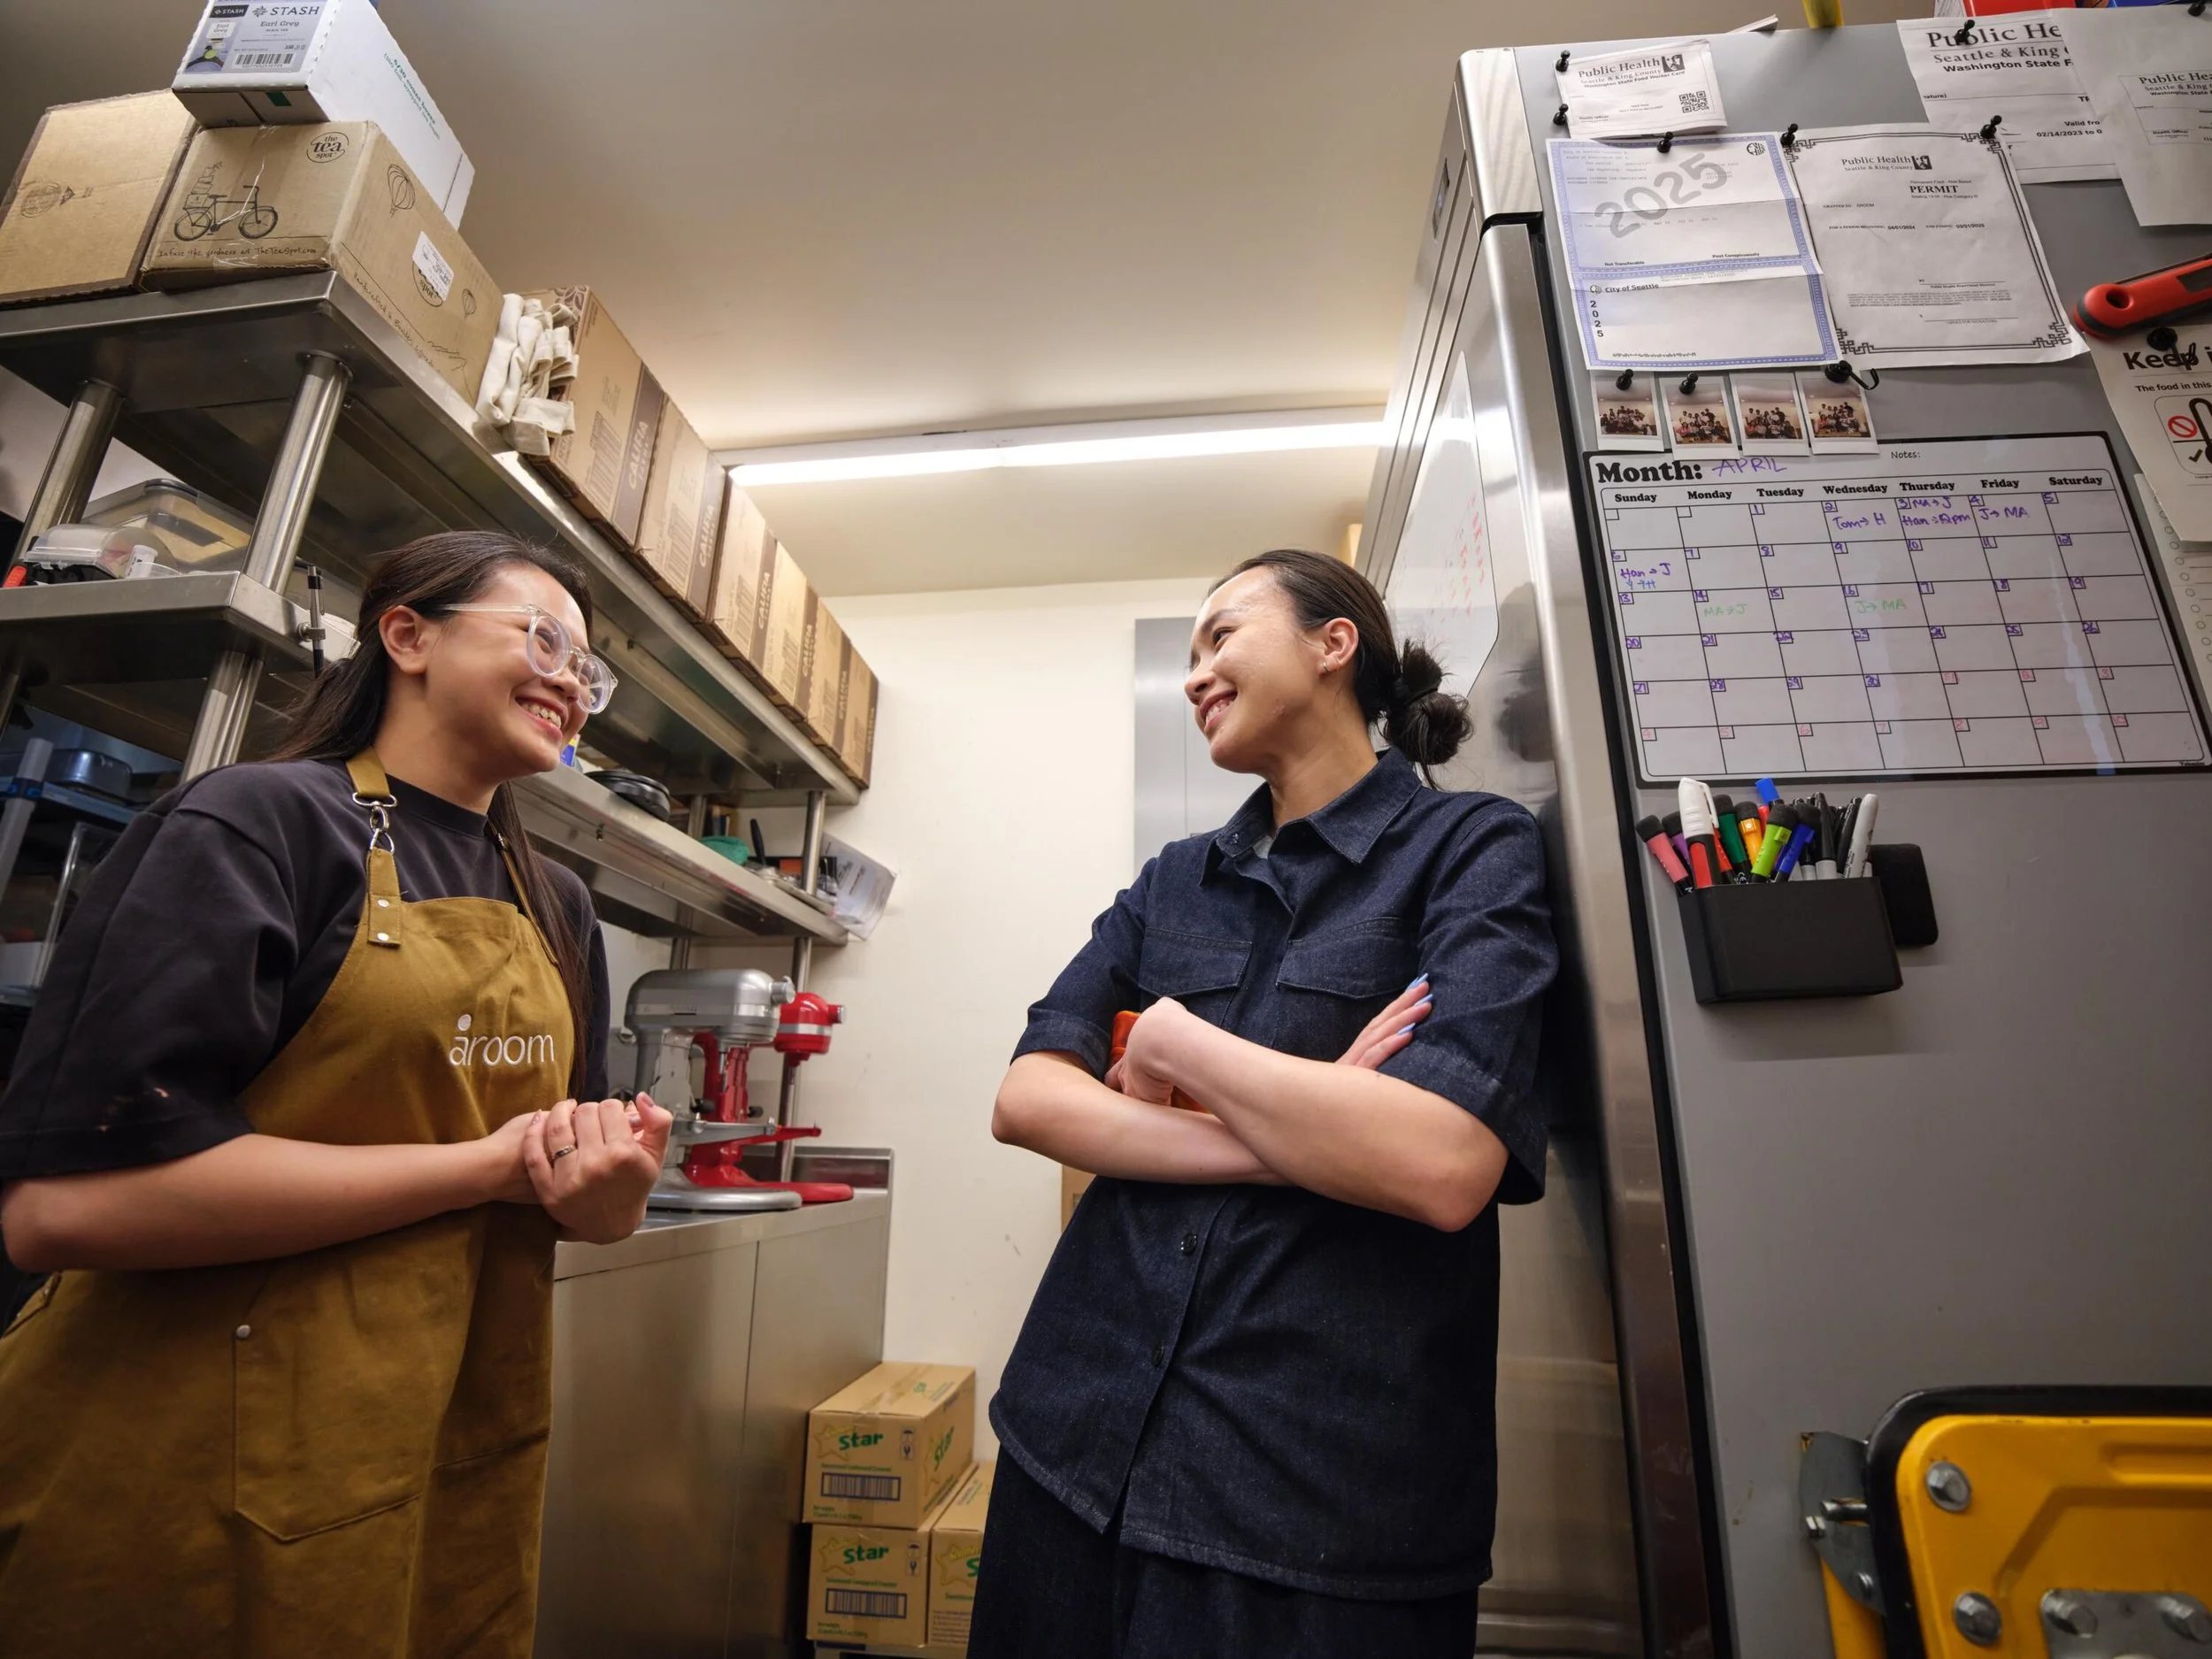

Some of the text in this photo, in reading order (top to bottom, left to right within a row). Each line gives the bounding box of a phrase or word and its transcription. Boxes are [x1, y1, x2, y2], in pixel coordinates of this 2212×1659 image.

[270, 6, 319, 16] STASH
[1933, 46, 2059, 64] Seattle & King
[1578, 58, 1661, 78] Public Health
[1943, 59, 2061, 73] Washington State
[2139, 73, 2186, 84] Public
[313, 142, 342, 152] tea
[1841, 156, 1911, 166] Public Health
[1909, 185, 1959, 194] PERMIT
[1594, 152, 1728, 239] 2025
[157, 249, 185, 258] Infuse
[188, 248, 202, 257] the
[205, 249, 236, 258] goodness
[419, 279, 436, 298] spot
[2123, 351, 2199, 371] Keep
[628, 420, 649, 490] CALIFIA
[1891, 450, 1921, 459] Notes:
[1595, 460, 1703, 483] Month:
[1712, 457, 1787, 478] APRIL
[1614, 476, 2103, 503] Sunday Monday Tuesday Wednesday Thursday Friday Saturday
[1898, 497, 1909, 508] 3
[1969, 495, 1981, 505] 4
[2042, 492, 2055, 503] 5
[1753, 504, 1759, 514] 1
[1824, 502, 1835, 511] 2
[1978, 506, 2029, 520] J MA
[1832, 512, 1886, 531] Tom H
[1902, 514, 1929, 526] Han
[698, 504, 716, 567] CALIFIA
[1761, 546, 1770, 557] 8
[1834, 542, 1844, 553] 9
[1611, 549, 1621, 560] 6
[1685, 549, 1694, 558] 7
[1620, 563, 1671, 579] Han J
[1619, 593, 1632, 603] 13
[1770, 588, 1781, 598] 15
[758, 572, 772, 630] CALIFIA
[1855, 598, 1907, 613] J MA
[1704, 603, 1747, 617] MA J
[2101, 668, 2110, 679] 3
[1709, 679, 1724, 689] 28
[1799, 725, 1810, 735] 6
[838, 1432, 884, 1451] Star
[842, 1544, 890, 1565] Star
